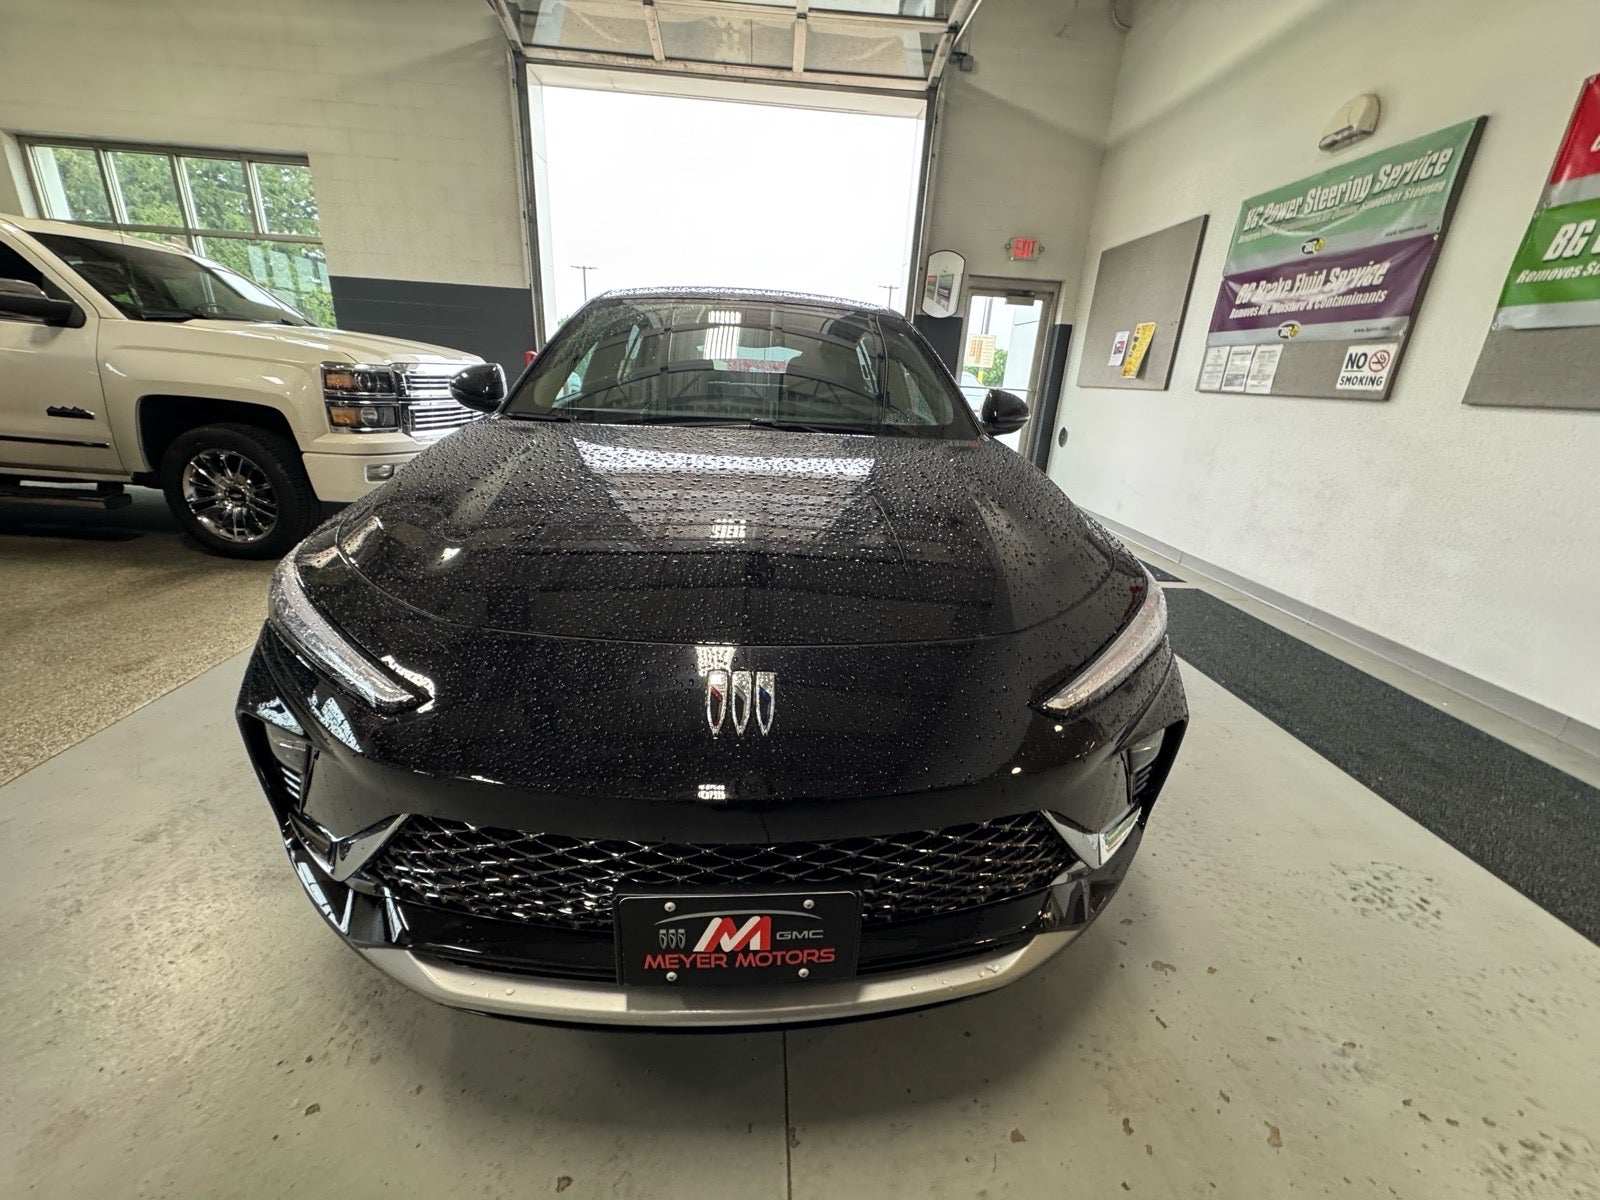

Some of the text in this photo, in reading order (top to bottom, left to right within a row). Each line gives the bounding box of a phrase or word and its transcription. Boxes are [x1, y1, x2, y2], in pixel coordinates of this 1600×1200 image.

[1259, 196, 1304, 226] Power
[1303, 174, 1374, 215] Steering
[1372, 148, 1454, 195] Service
[1013, 237, 1036, 257] EXIT
[1543, 219, 1597, 261] BG
[1251, 277, 1293, 302] Brake
[1291, 271, 1327, 297] Fluid
[1322, 260, 1391, 293] Service
[1515, 265, 1584, 284] Removes
[1314, 289, 1388, 310] Contaminants
[1345, 352, 1368, 370] NO
[1339, 375, 1383, 387] SMOKING
[776, 929, 825, 940] GMC
[644, 948, 836, 970] MEYER MOTORS
